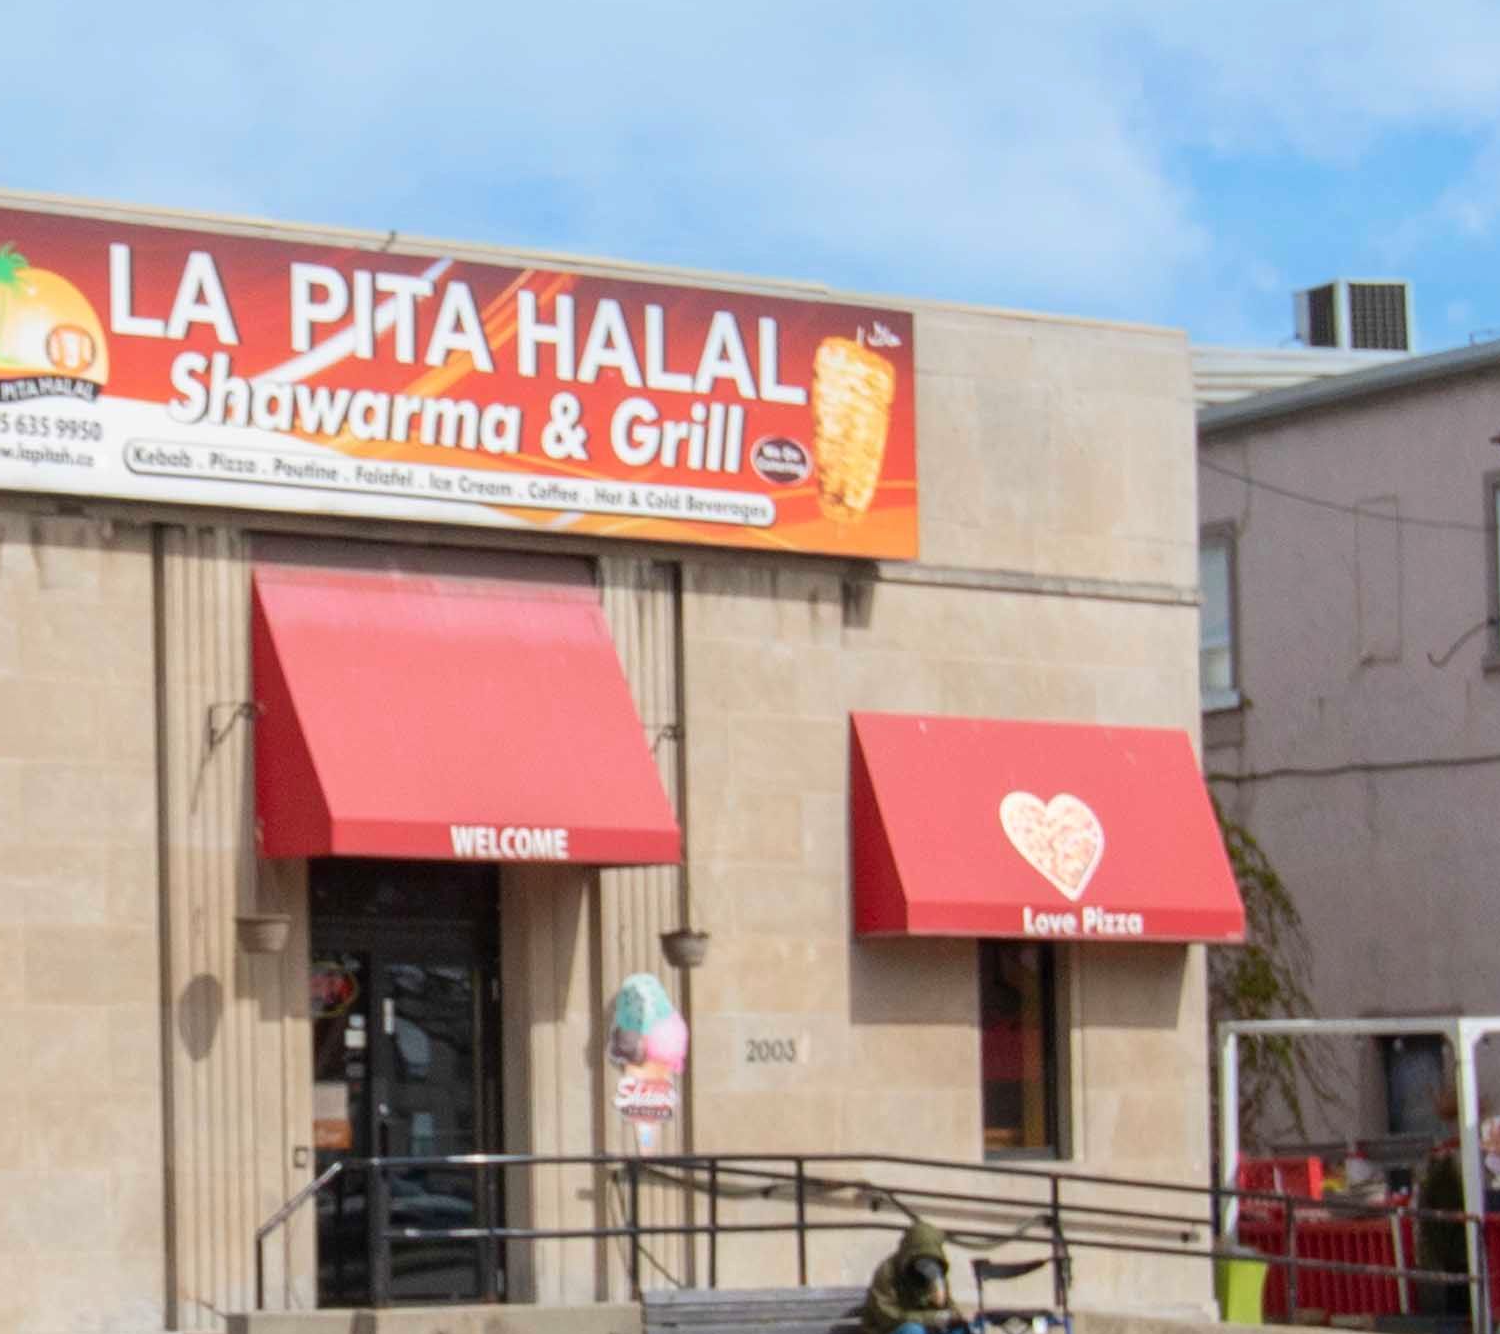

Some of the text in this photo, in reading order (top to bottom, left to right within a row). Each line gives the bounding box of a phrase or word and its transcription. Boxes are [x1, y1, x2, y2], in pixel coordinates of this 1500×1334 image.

[109, 241, 808, 405] LA PITA HALAL
[15, 415, 51, 437] 635
[54, 417, 103, 442] 9950
[167, 350, 745, 474] Shawarma & Grill
[133, 447, 769, 524] Kebab Pizza Poutine Falafel Ice Cream Coffee Hot & Cold Beverages
[450, 824, 569, 860] WELCOME
[1022, 904, 1144, 935] Love Pizza
